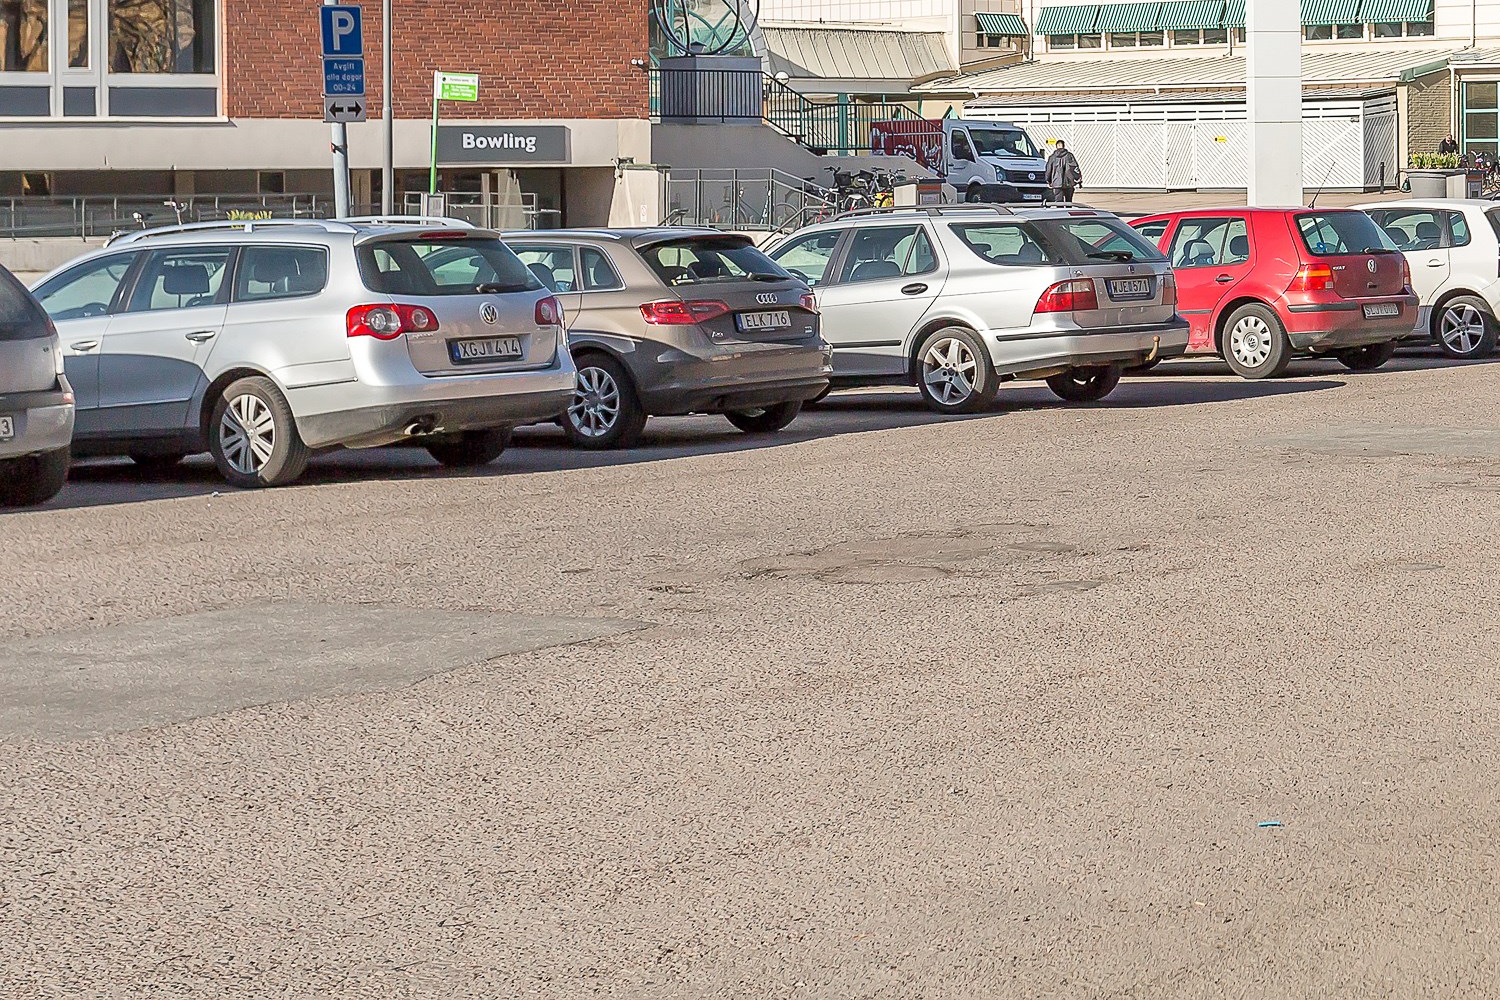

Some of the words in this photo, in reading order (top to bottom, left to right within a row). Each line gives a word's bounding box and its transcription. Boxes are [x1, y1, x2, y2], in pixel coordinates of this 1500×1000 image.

[332, 10, 355, 51] P
[333, 63, 355, 72] Avgift
[333, 84, 356, 92] 00-24
[462, 133, 537, 153] Bowling
[1132, 279, 1148, 292] 571
[745, 314, 766, 327] ELK
[768, 313, 787, 326] 716
[459, 342, 487, 357] XGJ
[495, 339, 519, 354] 414
